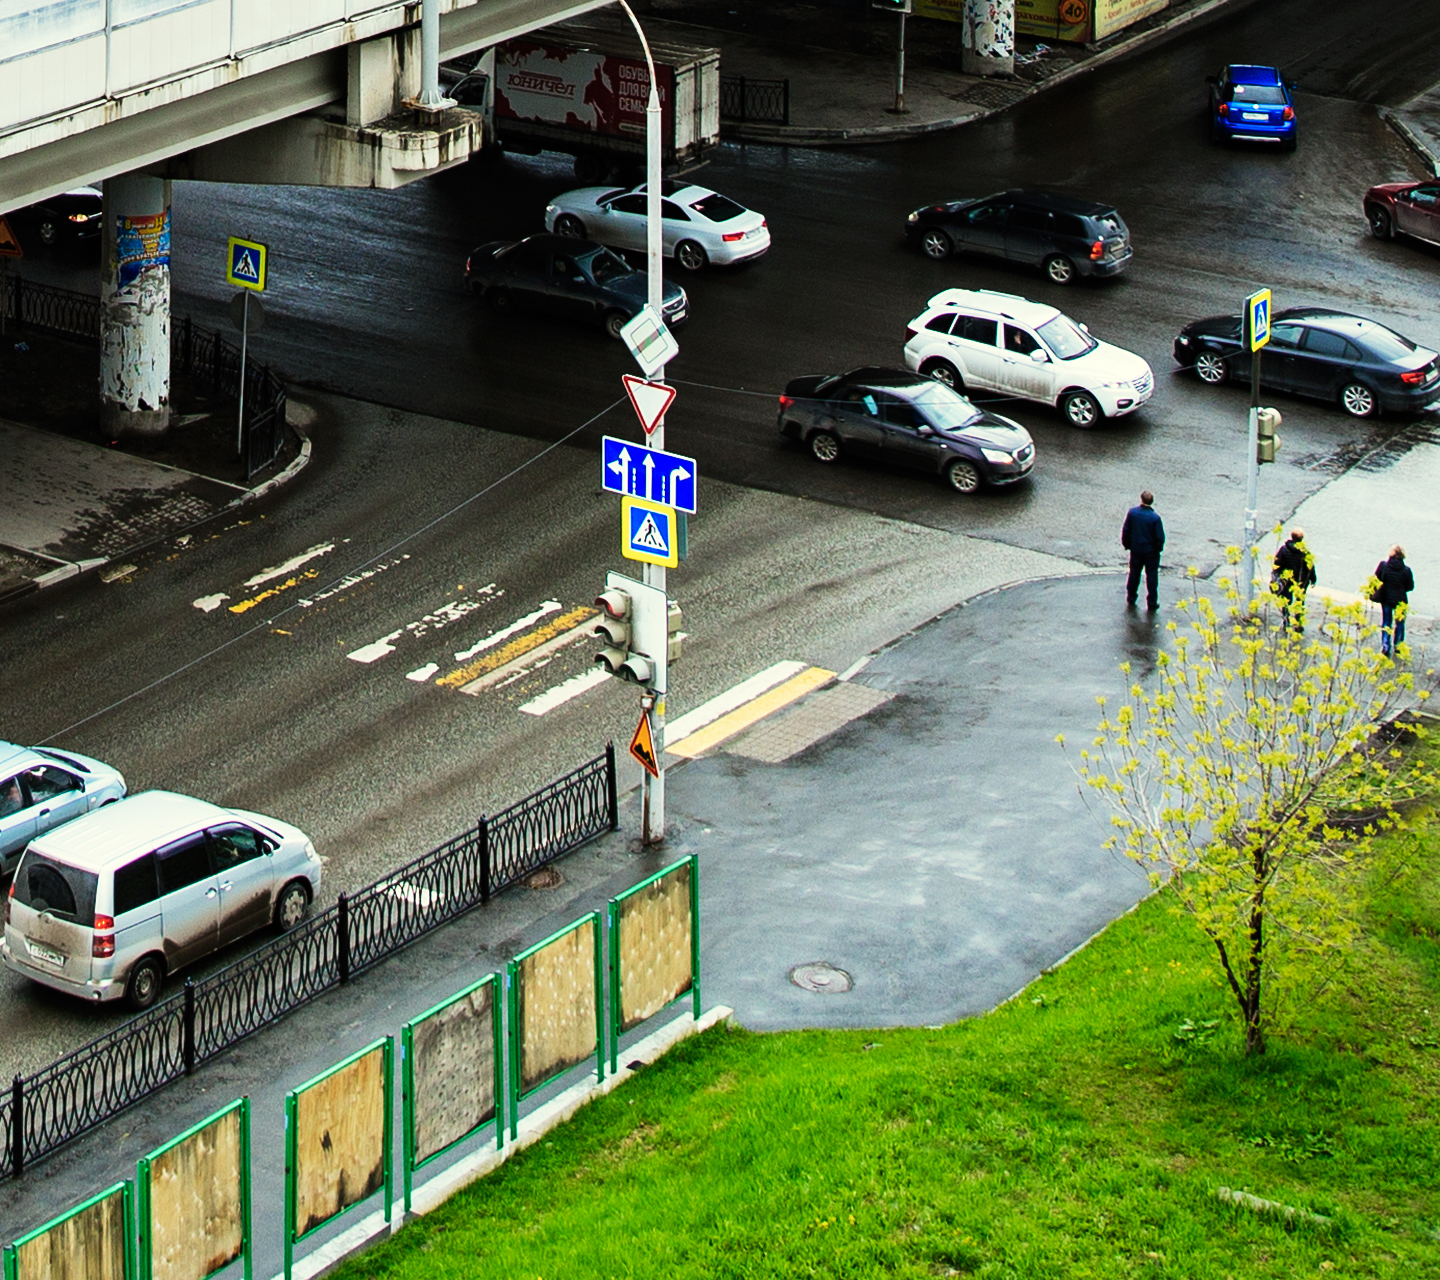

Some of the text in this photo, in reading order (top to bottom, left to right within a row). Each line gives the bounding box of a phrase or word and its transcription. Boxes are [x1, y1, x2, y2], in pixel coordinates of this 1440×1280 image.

[1065, 2, 1082, 18] 40
[619, 64, 650, 82] ОБУВЬ
[619, 81, 639, 97] ДЛЯ
